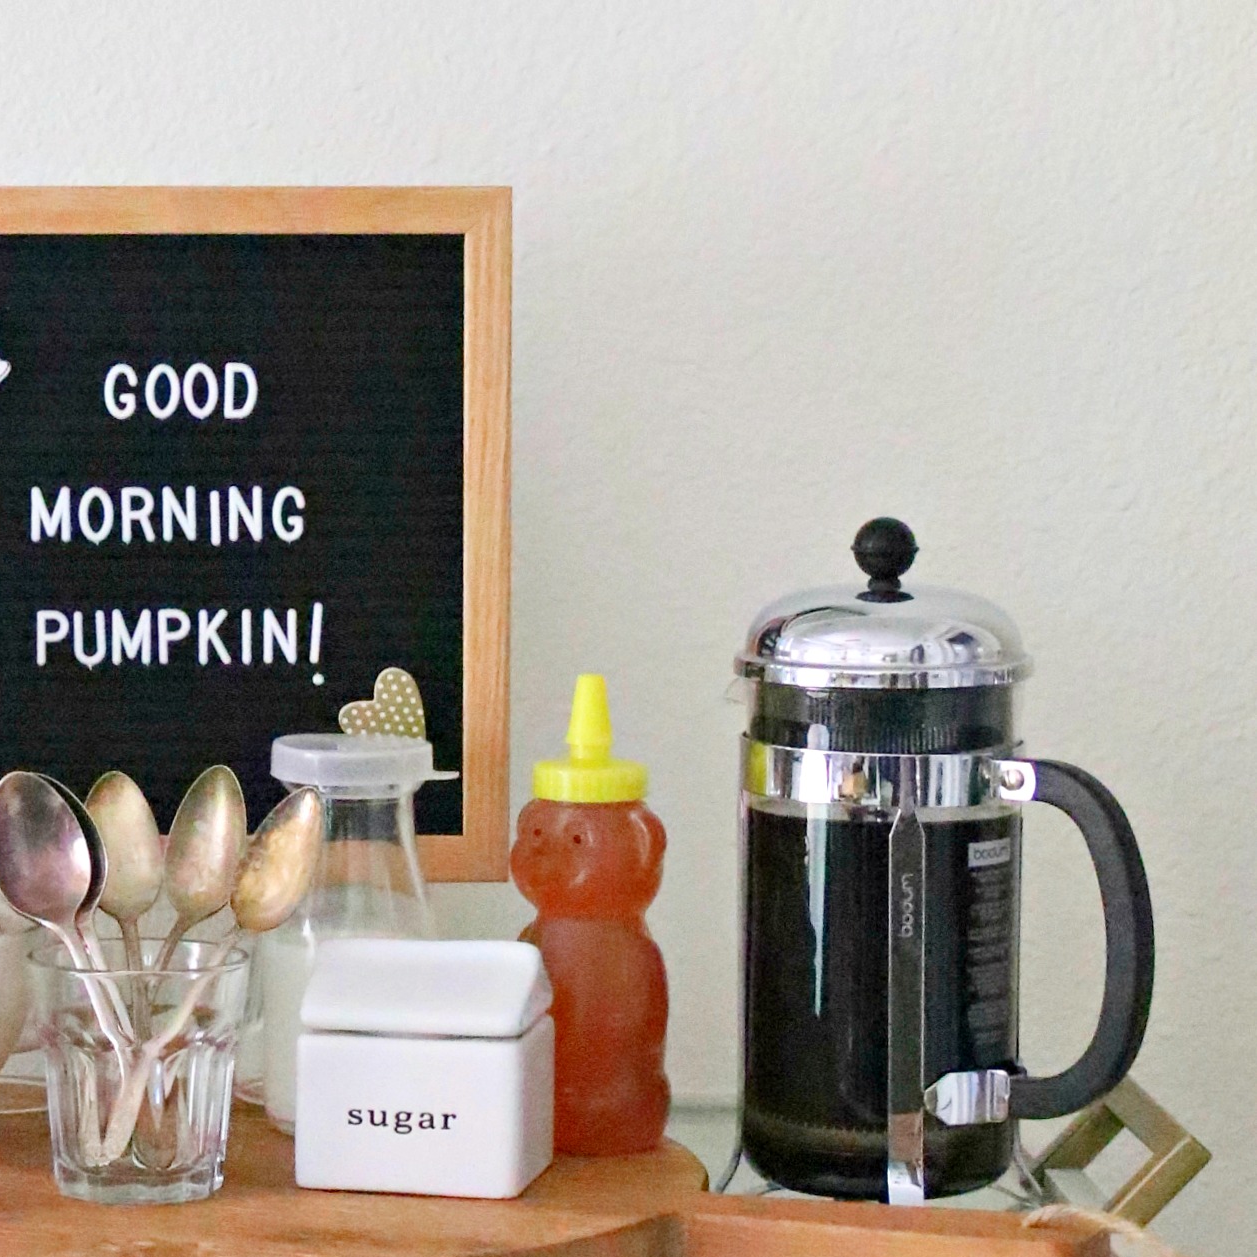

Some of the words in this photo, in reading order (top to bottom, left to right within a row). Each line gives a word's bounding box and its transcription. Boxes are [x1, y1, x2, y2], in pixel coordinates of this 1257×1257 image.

[104, 362, 260, 421] GOOD
[30, 486, 307, 548] MORNING
[36, 602, 326, 687] PUMPKIN!
[347, 1108, 457, 1135] sugar
